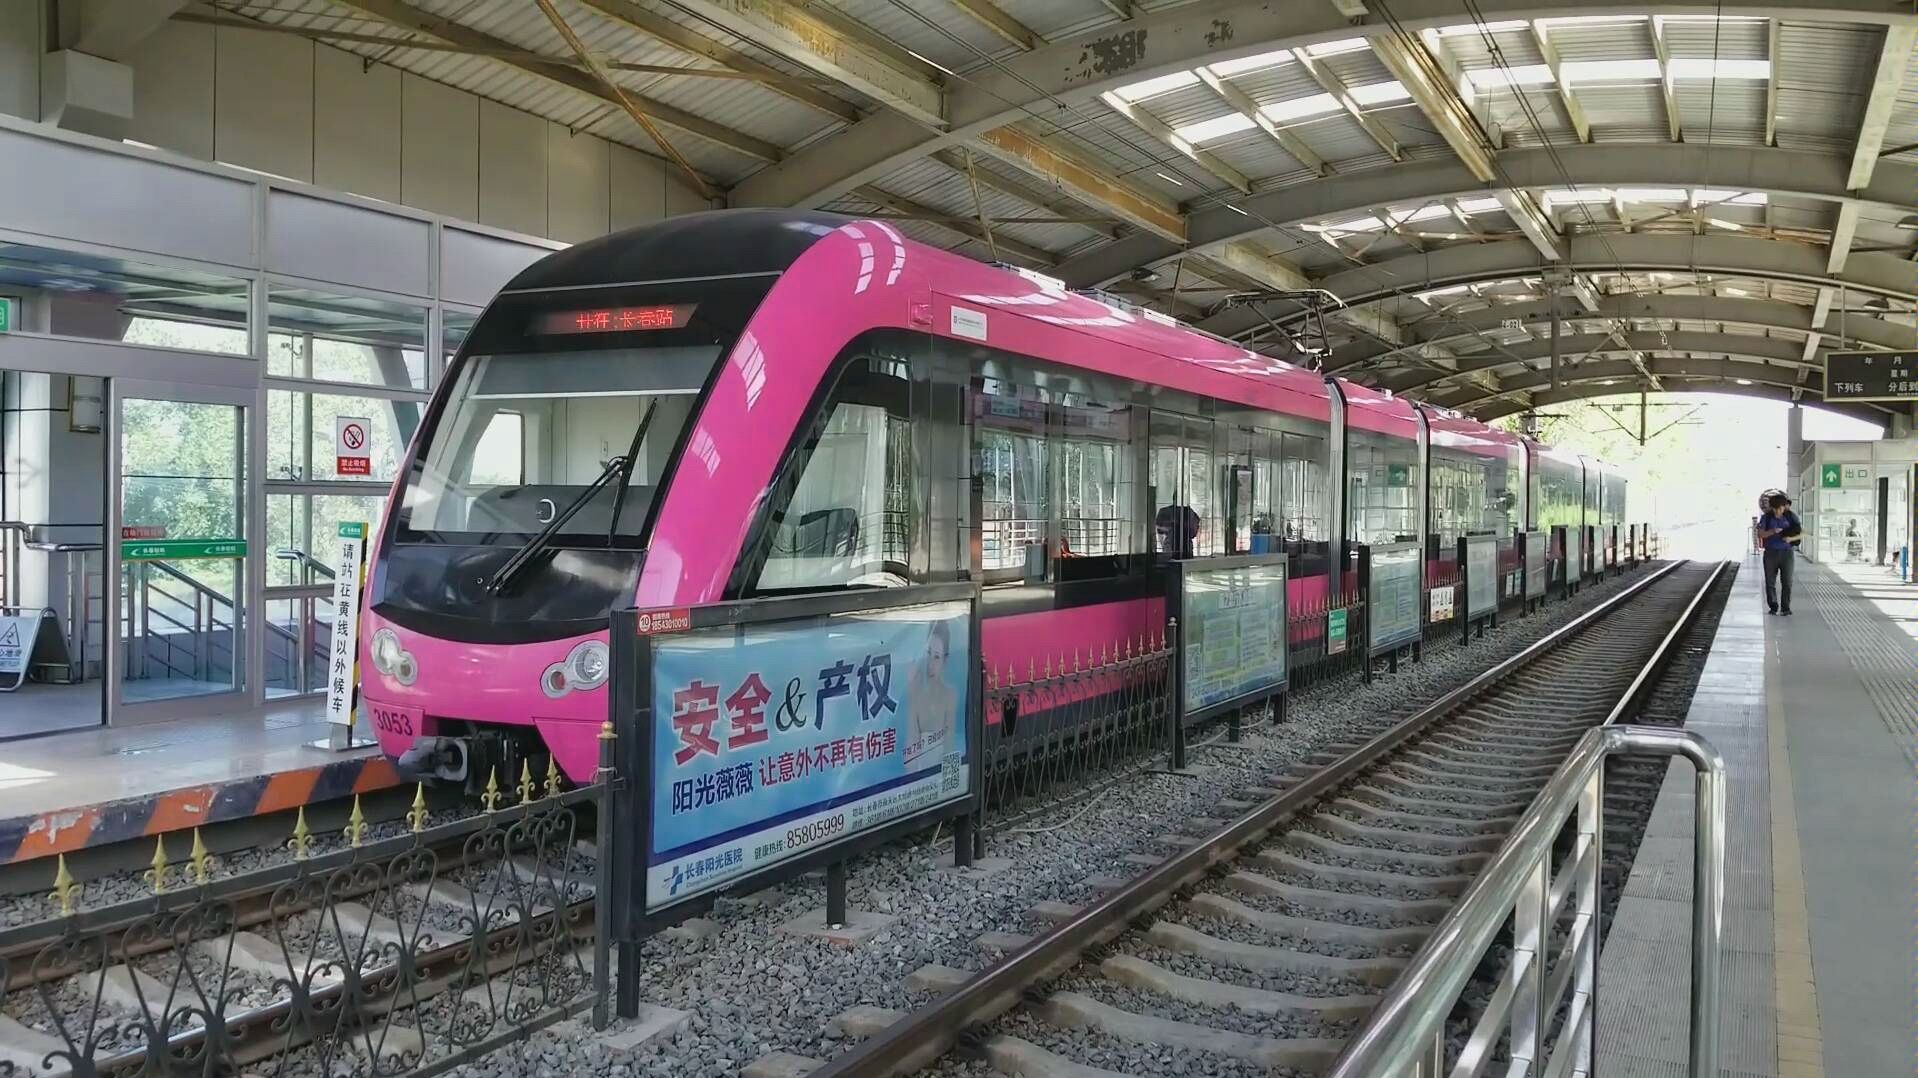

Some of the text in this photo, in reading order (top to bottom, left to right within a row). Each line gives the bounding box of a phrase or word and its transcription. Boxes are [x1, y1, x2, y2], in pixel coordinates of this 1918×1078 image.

[1893, 355, 1902, 365] 月
[1834, 382, 1864, 393] 下列车
[1845, 468, 1868, 479] 出口
[332, 543, 354, 713] 请站在黄线以外候车
[374, 708, 413, 737] 3053
[672, 727, 897, 815] 阳光薇薇 让意外不再有伤害
[786, 813, 845, 849] 85805999
[685, 847, 743, 881] 长春阳光医院
